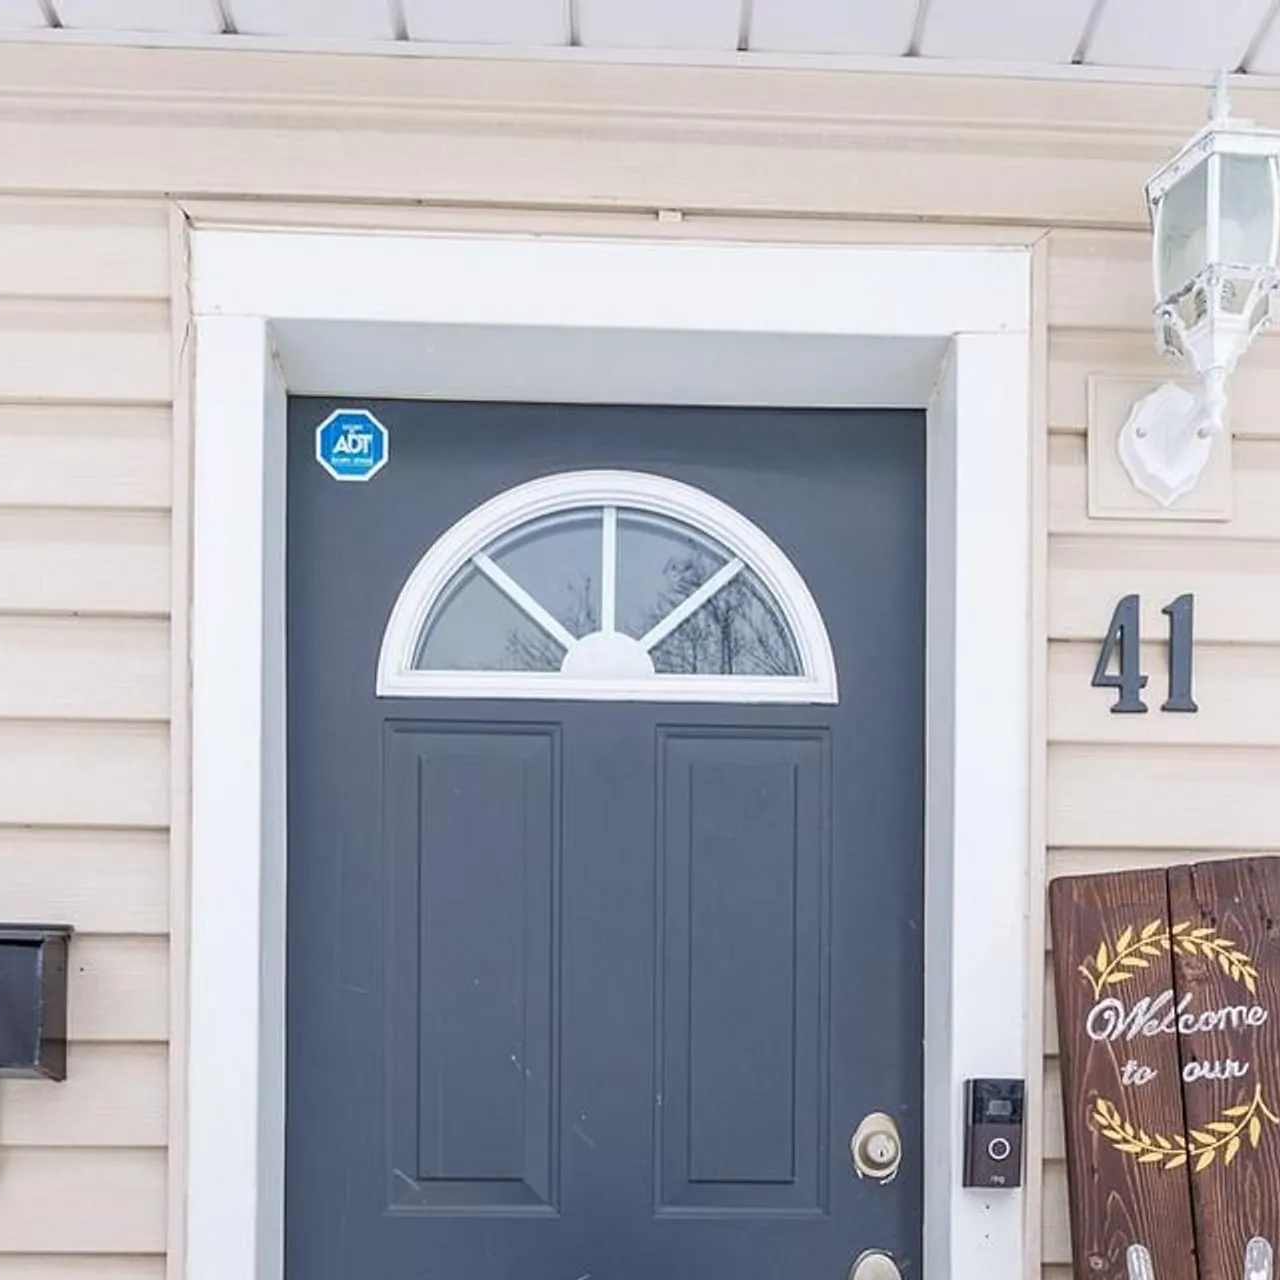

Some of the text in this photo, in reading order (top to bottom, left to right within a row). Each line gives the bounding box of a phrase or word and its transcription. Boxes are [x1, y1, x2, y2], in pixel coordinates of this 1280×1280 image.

[331, 434, 373, 454] ADT
[1090, 593, 1198, 714] 41
[1086, 990, 1268, 1041] Welcome
[1120, 1060, 1250, 1085] to our
